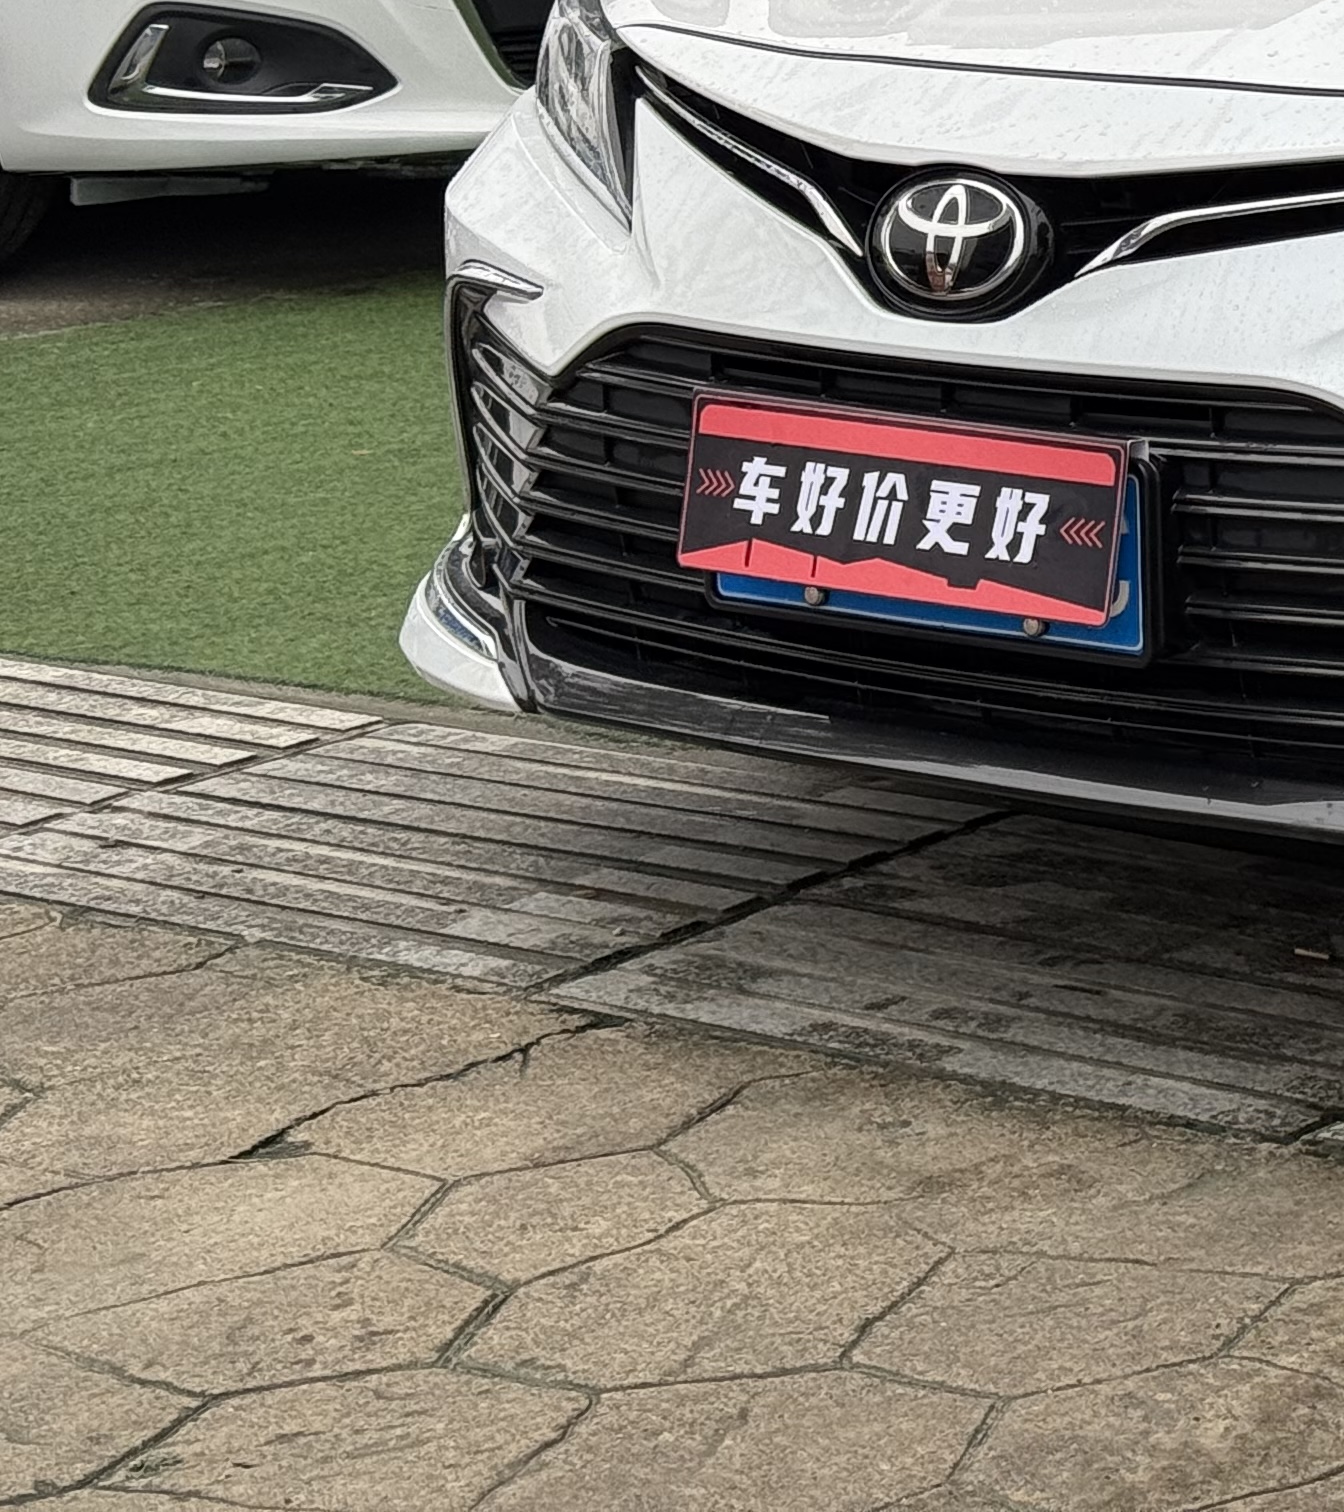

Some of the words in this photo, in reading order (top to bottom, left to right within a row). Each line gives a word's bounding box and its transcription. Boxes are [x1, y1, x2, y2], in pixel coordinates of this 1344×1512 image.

[732, 455, 1051, 565] 车好价更好
